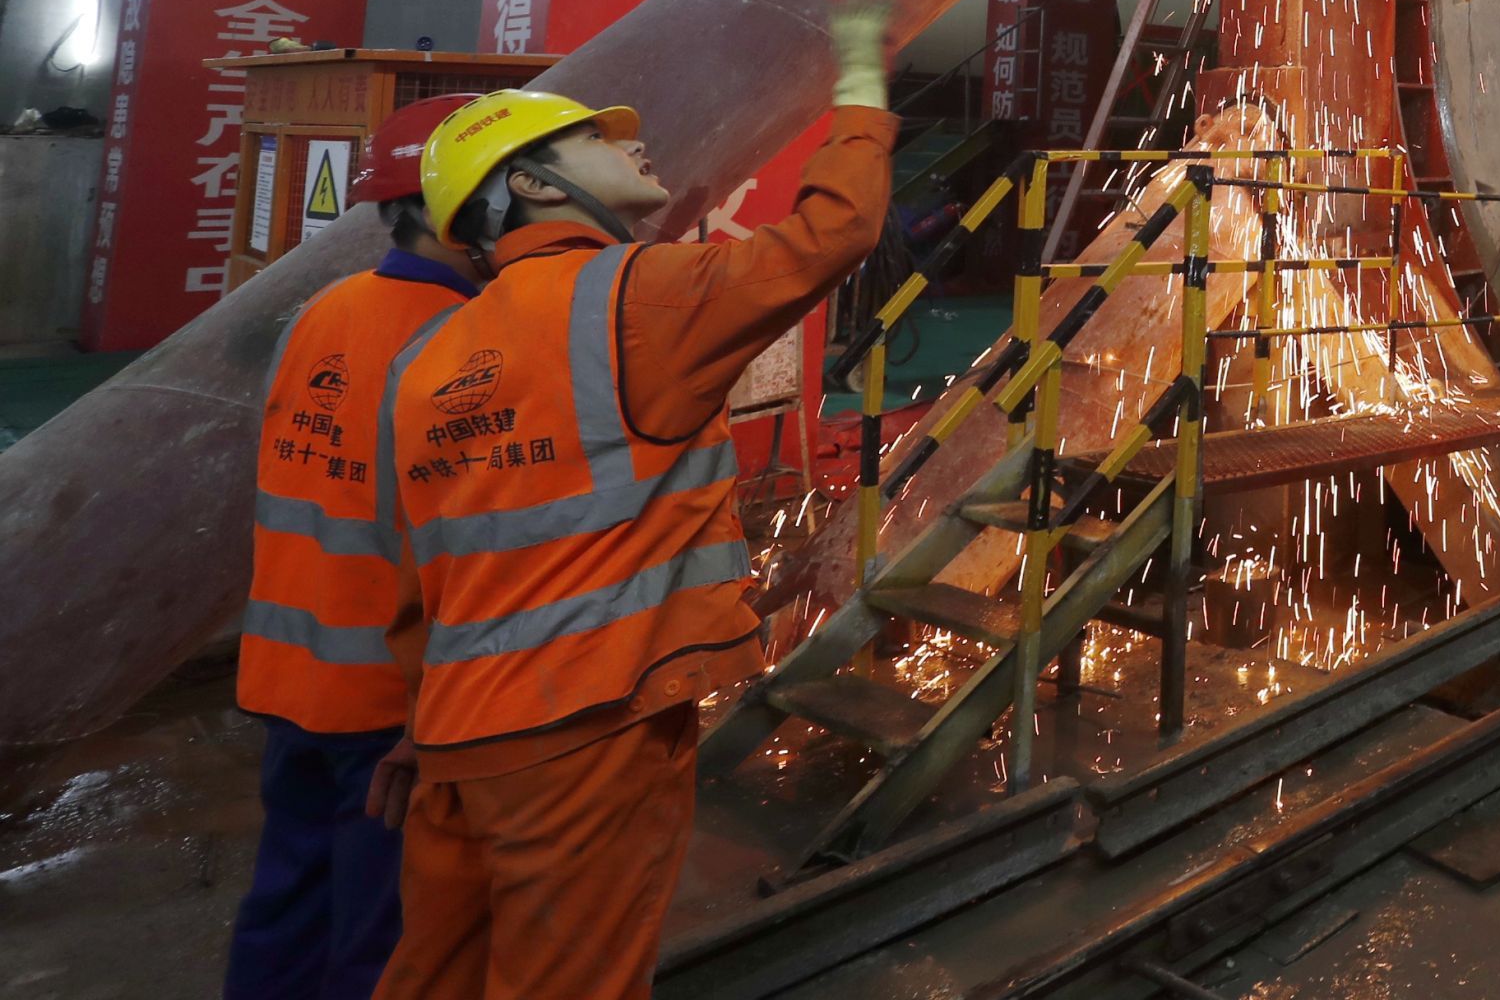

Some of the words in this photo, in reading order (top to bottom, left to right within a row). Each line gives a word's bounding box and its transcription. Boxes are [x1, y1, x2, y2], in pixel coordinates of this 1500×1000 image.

[992, 22, 1017, 120] 如何防
[455, 108, 511, 142] 中国铁建
[426, 408, 516, 447] 中国铁建
[408, 437, 555, 483] 中铁十一局集团
